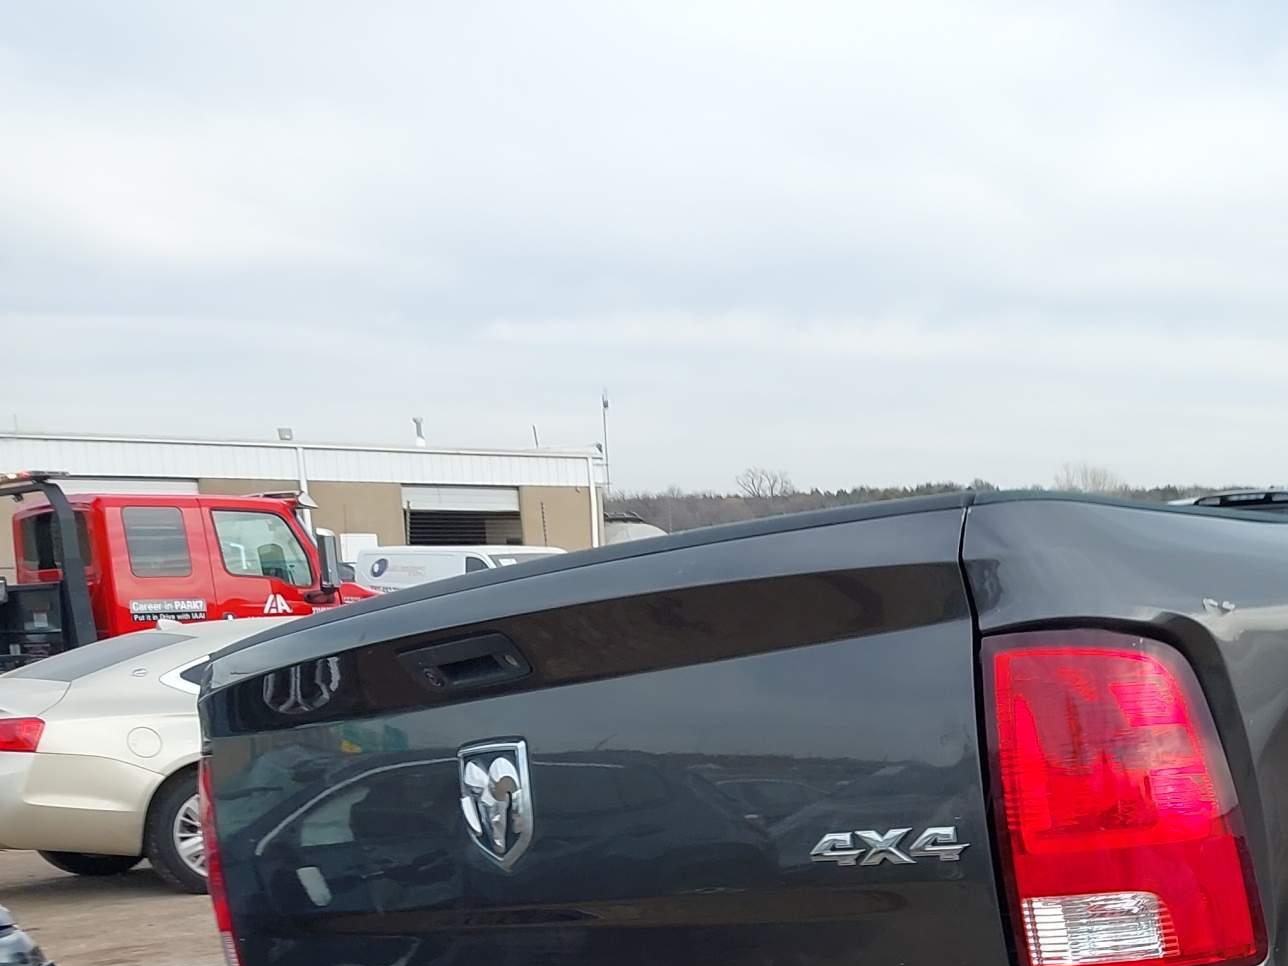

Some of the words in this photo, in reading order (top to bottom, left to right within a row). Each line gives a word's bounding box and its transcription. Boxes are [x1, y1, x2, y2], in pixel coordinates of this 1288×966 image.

[132, 601, 162, 612] Career
[164, 601, 173, 611] in
[174, 600, 204, 610] PARK?
